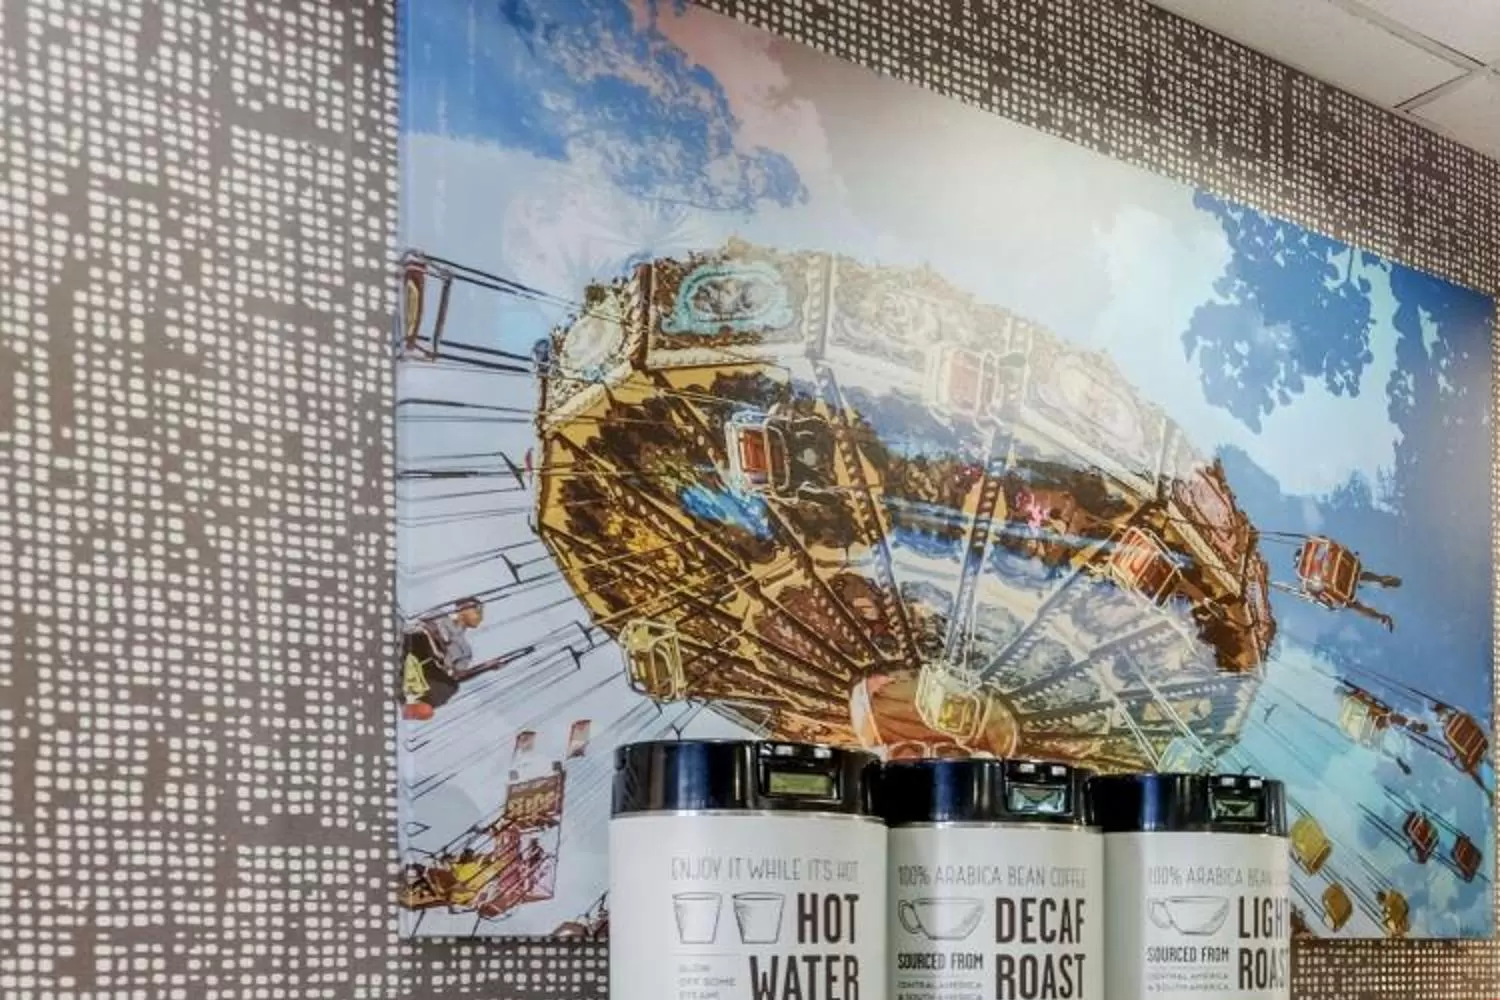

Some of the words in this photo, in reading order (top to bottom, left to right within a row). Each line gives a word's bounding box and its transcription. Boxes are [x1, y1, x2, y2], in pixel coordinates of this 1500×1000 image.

[671, 857, 722, 881] ENJOY
[728, 857, 742, 881] IT
[749, 857, 802, 881] WHILE
[935, 865, 1002, 887] ARABICA
[1007, 866, 1045, 888] BEAN
[1186, 866, 1243, 887] ARABICA
[797, 892, 860, 945] HOT
[995, 896, 1086, 944] DECAF
[897, 952, 945, 970] SOURCED
[950, 952, 984, 970] FROM
[1147, 946, 1197, 963] SOURCED
[1201, 946, 1229, 963] FROM
[995, 953, 1087, 1000] ROAST
